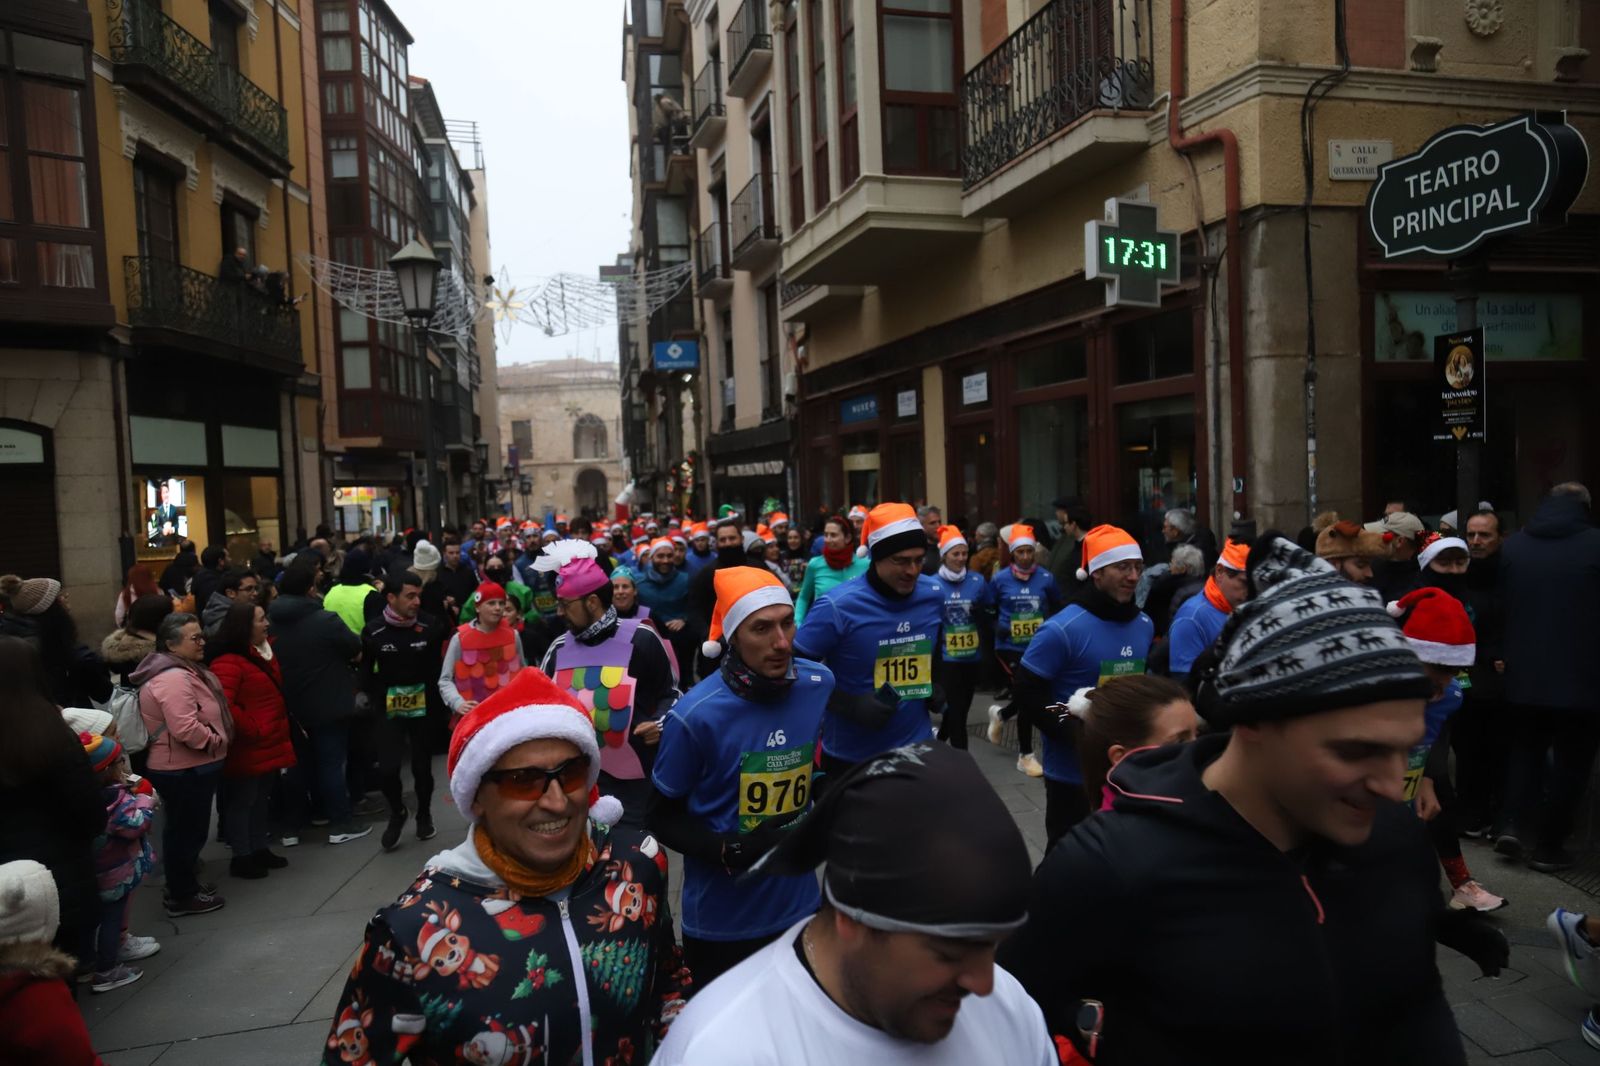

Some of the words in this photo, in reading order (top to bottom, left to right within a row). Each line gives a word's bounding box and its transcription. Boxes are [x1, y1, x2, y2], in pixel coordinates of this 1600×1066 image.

[1351, 145, 1379, 154] CALLE
[1356, 156, 1369, 164] DE
[1404, 149, 1501, 199] TEATRO
[1392, 184, 1520, 239] PRINCIPAL
[1104, 236, 1167, 270] 17:31
[1415, 303, 1431, 316] Un
[1487, 301, 1499, 315] la
[1500, 301, 1537, 316] salud
[1441, 319, 1456, 333] de
[896, 621, 911, 634] 46
[950, 634, 975, 648] 413
[1120, 645, 1134, 658] 46
[882, 657, 918, 682] 1115
[391, 695, 417, 709] 1124
[766, 729, 787, 748] 46
[747, 774, 807, 814] 976
